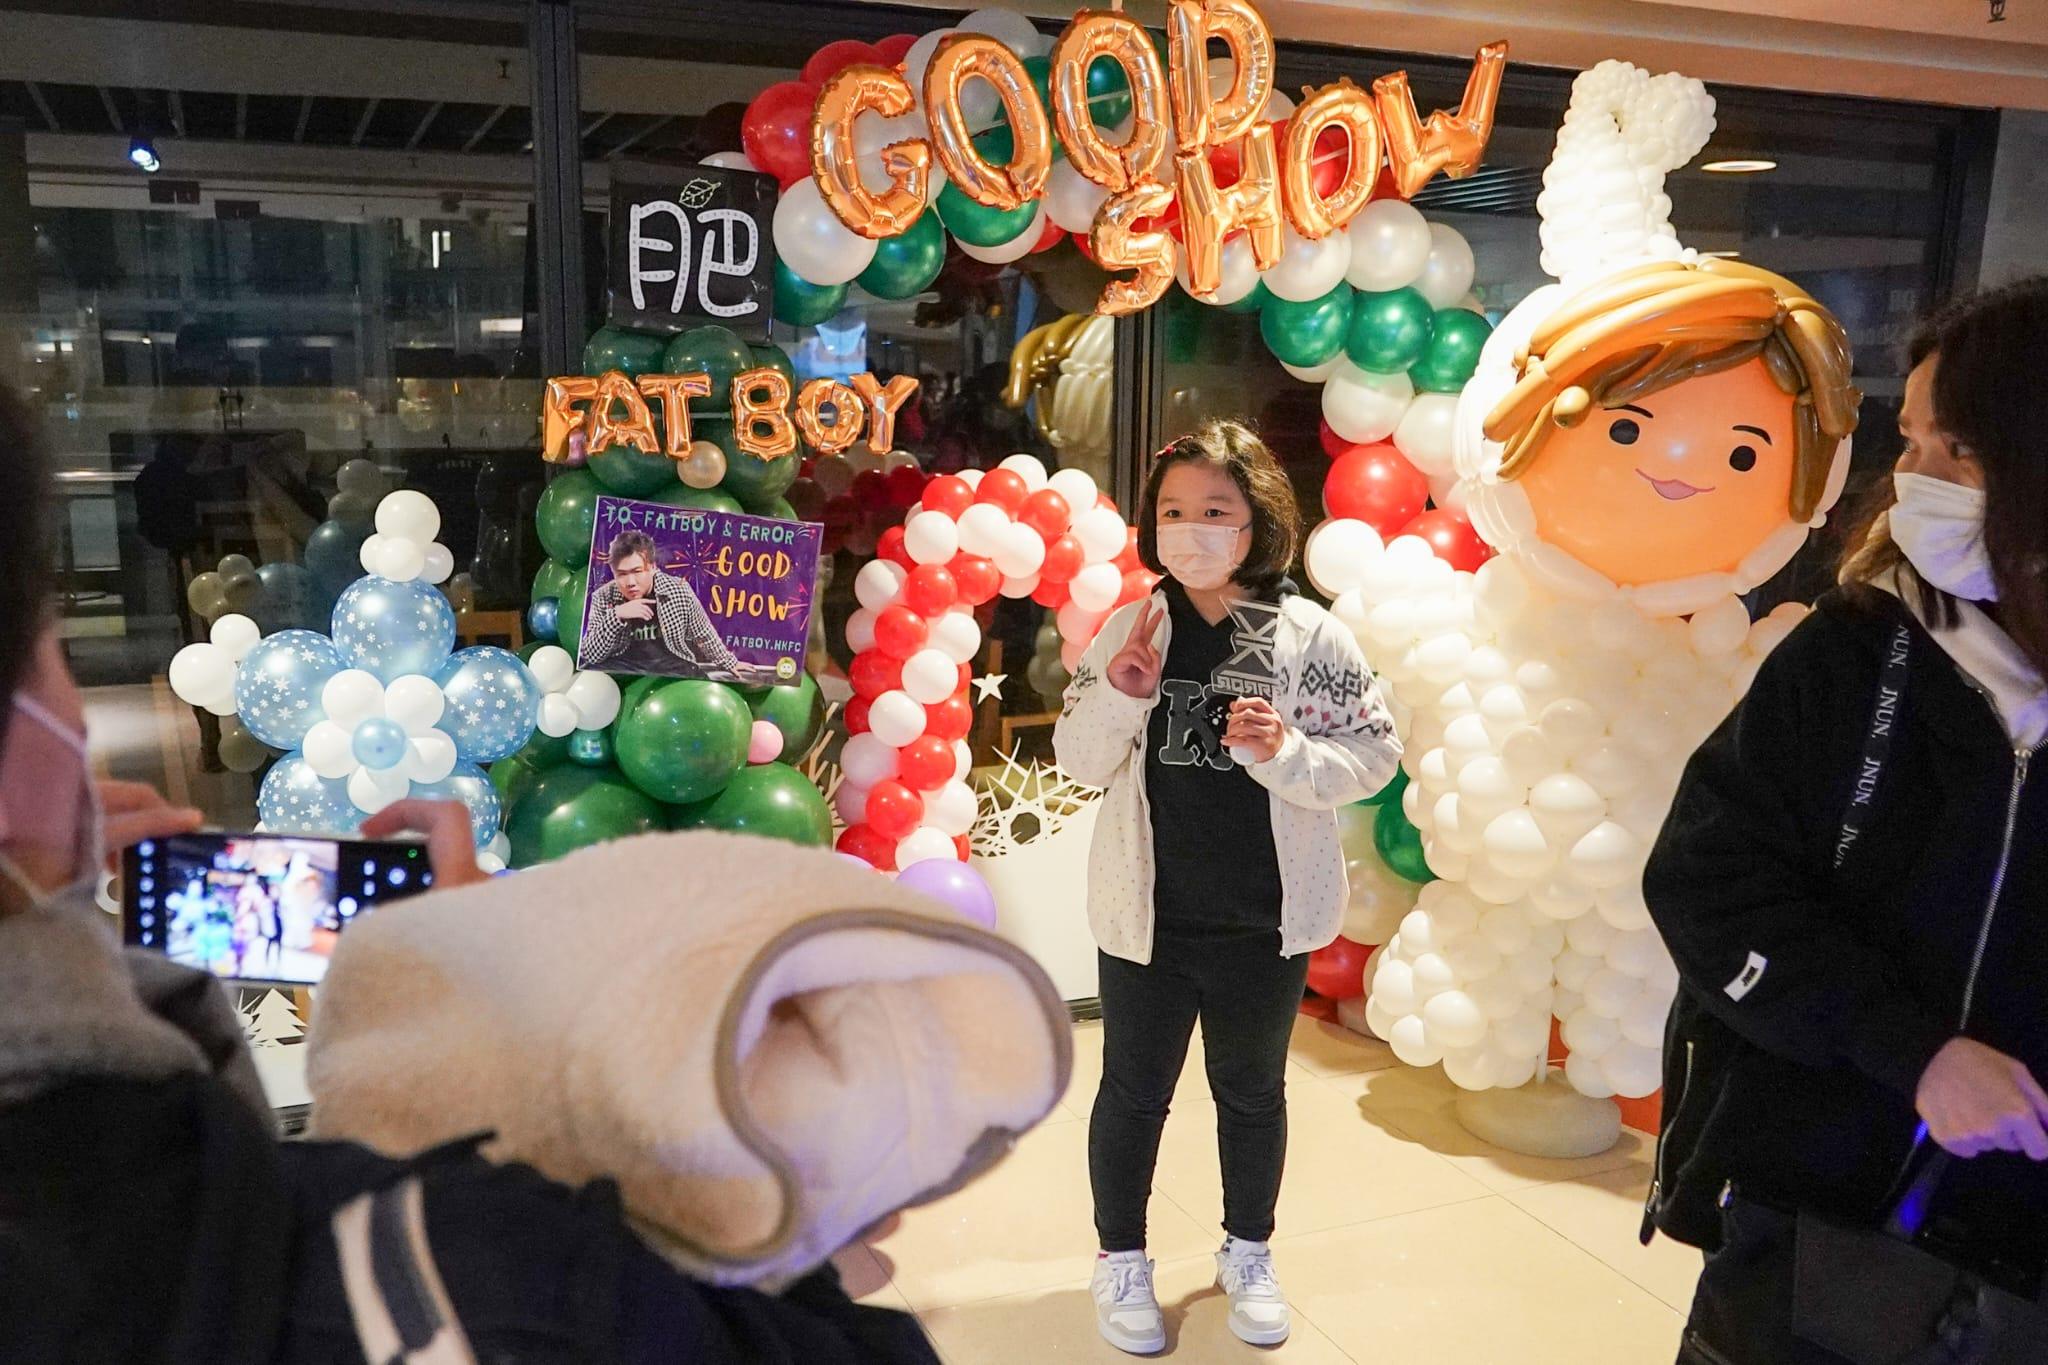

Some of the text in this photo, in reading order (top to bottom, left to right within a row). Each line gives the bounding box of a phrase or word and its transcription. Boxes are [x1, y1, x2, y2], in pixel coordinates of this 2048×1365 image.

[809, 0, 1274, 238] GOOD
[1087, 39, 1508, 316] SHOW
[629, 201, 759, 317] 肥
[542, 367, 920, 462] FAT BOY
[605, 505, 796, 545] TO FATBOY & ERROR
[717, 545, 791, 580] GOOD
[710, 584, 789, 622] SHOW
[725, 635, 802, 653] FATBOY.HKFC
[1887, 624, 1911, 668] NUN.
